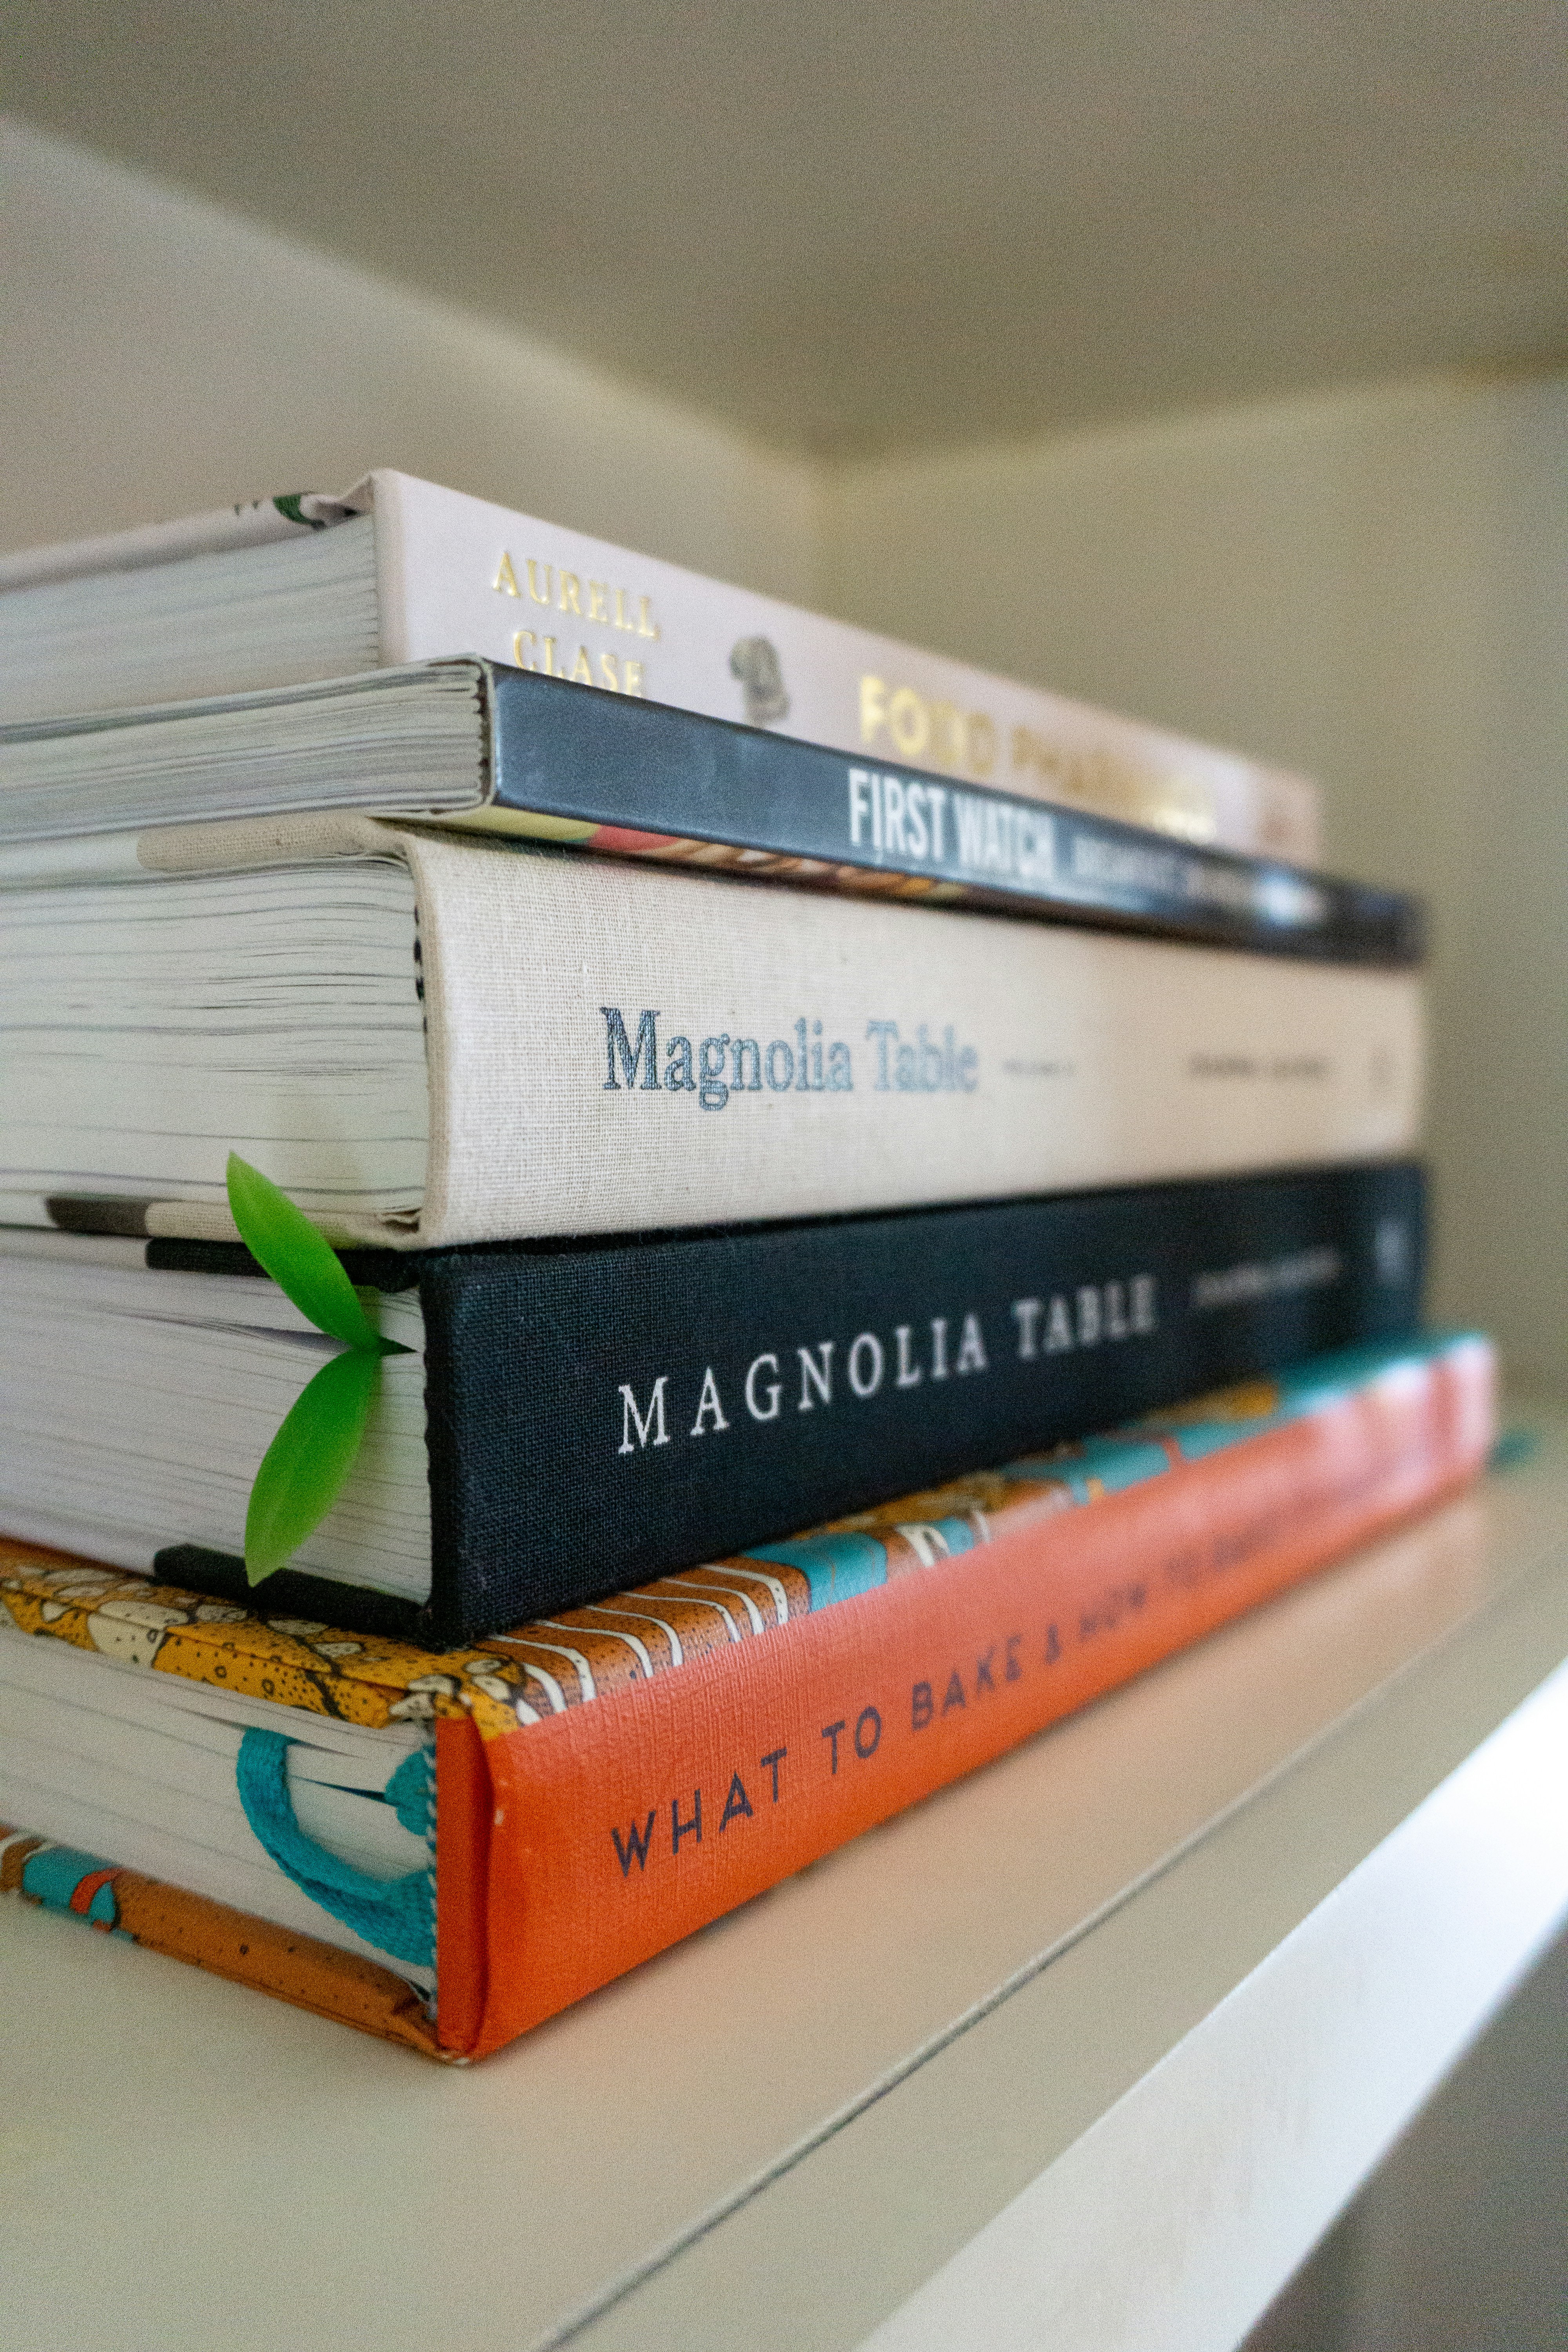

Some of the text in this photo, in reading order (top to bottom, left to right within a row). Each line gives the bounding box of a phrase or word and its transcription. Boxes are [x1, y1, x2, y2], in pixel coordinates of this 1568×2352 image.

[492, 550, 661, 640] AURELL
[848, 767, 948, 859] FIRST
[952, 789, 1058, 881] WATCH
[599, 1006, 979, 1111] Magnolia Table
[618, 1313, 988, 1454] MAGNOLIA
[1017, 1274, 1156, 1361] TABLE
[611, 1747, 787, 1878] WHAT
[821, 1705, 883, 1775] TO
[911, 1635, 1023, 1732] BAKE
